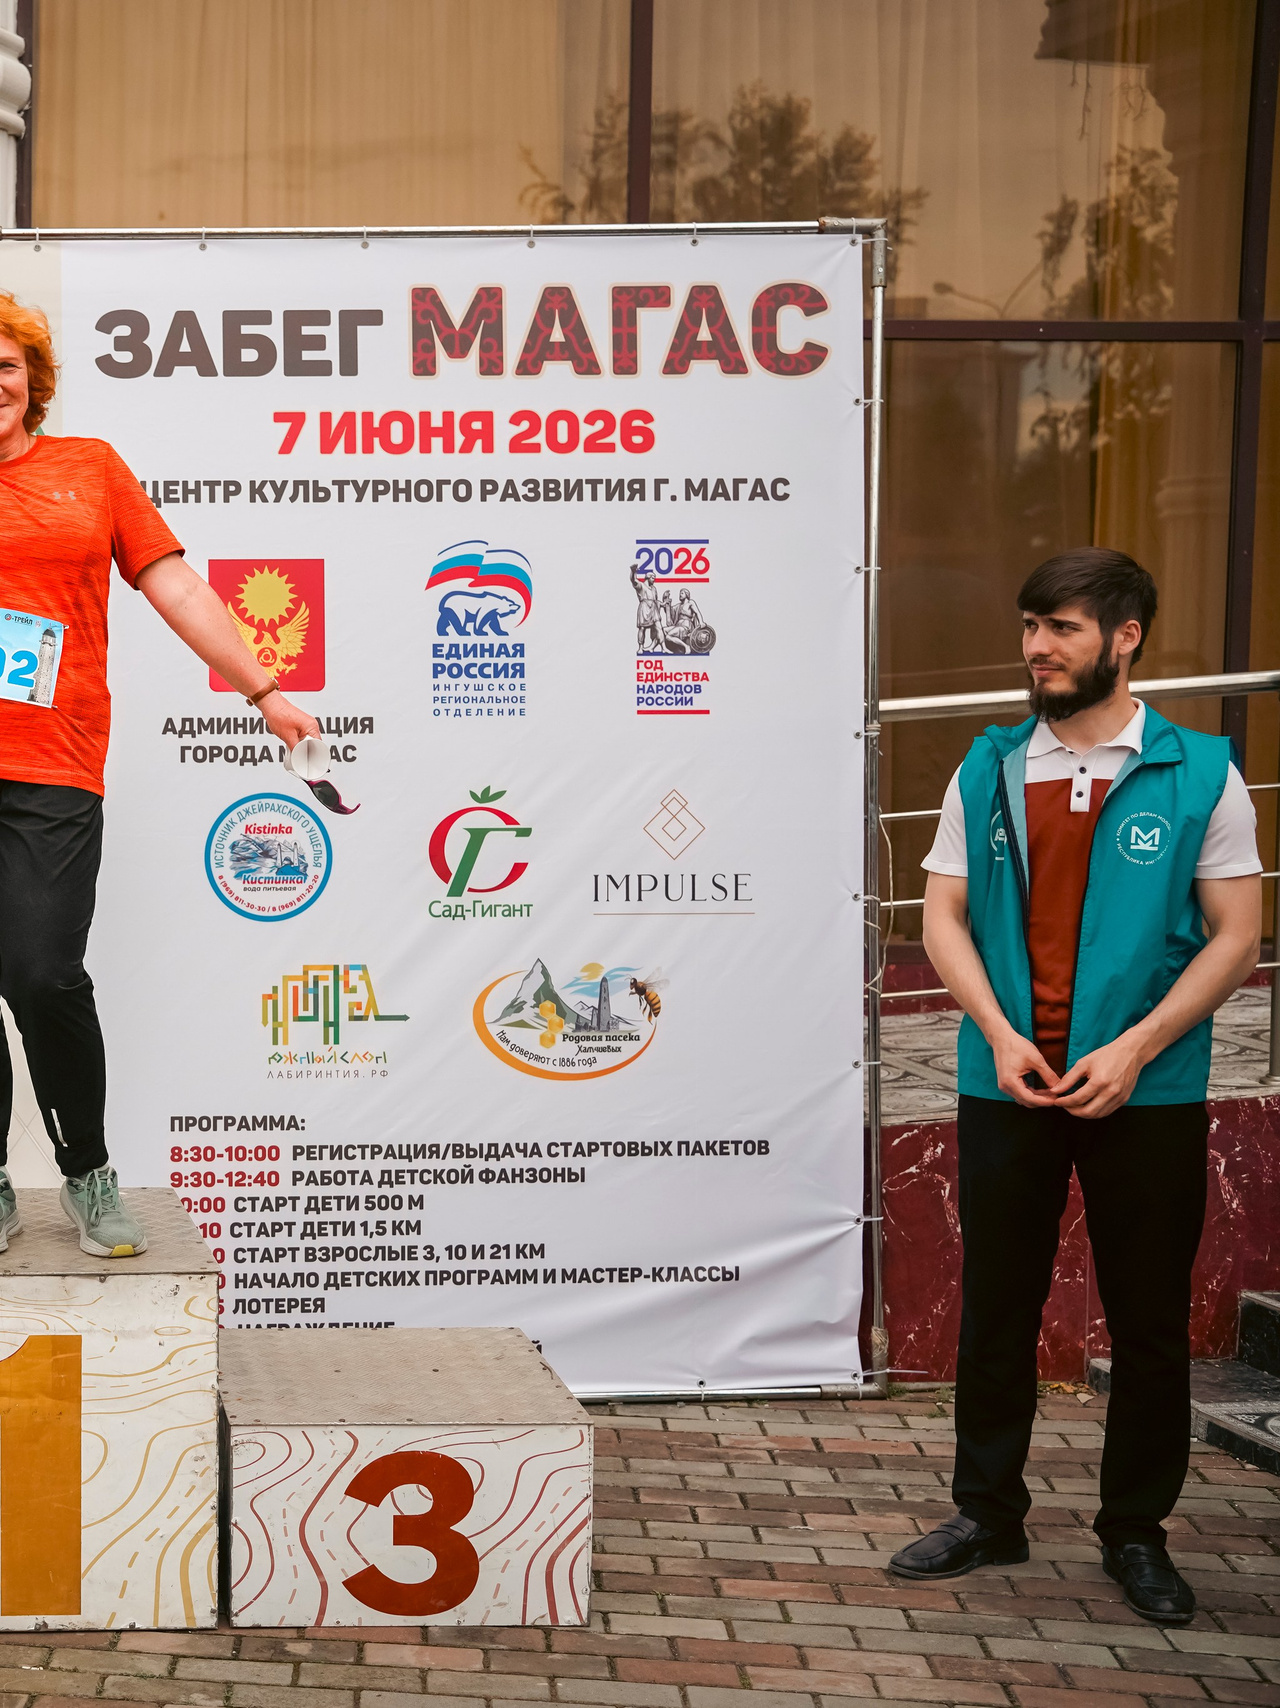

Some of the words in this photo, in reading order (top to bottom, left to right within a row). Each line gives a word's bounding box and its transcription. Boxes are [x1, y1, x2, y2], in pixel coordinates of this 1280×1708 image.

[94, 309, 382, 379] ЗАБЕГ
[410, 284, 830, 378] МАГАС
[273, 411, 306, 454] 7
[319, 411, 493, 454] ИЮНЯ
[508, 410, 656, 453] 2026
[139, 480, 242, 508] ЦЕНТР
[248, 477, 472, 505] КУЛЬТУРНОГО
[480, 477, 645, 503] РАЗВИТИЯ
[654, 477, 678, 502] Г.
[685, 477, 790, 502] МАГАС
[635, 547, 710, 575] 2026
[432, 643, 525, 660] ЕДИНАЯ
[432, 662, 525, 679] РОССИЯ
[636, 660, 664, 671] ГОД
[433, 683, 526, 692] ИНГУШСКОЕ
[636, 672, 709, 684] ЕДИНСТВА
[433, 695, 526, 705] РЕГИОНАЛЬНОЕ
[636, 684, 702, 696] НАРОДОВ
[636, 696, 694, 707] РОССИИ
[433, 708, 526, 718] ОТДЕЛЕНИЕ
[179, 745, 273, 766] ГОРОДА
[214, 817, 238, 868] ИСТОЧНИК
[236, 801, 310, 829] ДЖЕЙРАХСКОГО
[305, 827, 323, 868] УЩЕЛЬЯ
[244, 823, 293, 835] Kistinka
[242, 874, 304, 885] Кистинка
[243, 885, 261, 893] вода
[593, 873, 754, 902] IMPULSE
[428, 899, 534, 921] Сад-Гигант
[496, 1029, 510, 1047] Нам
[509, 1042, 551, 1067] доверяют
[552, 1059, 558, 1067] с
[558, 1057, 576, 1068] 1886
[577, 1056, 598, 1068] года
[562, 1033, 603, 1044] Родовая
[605, 1033, 641, 1043] пасека
[170, 1115, 306, 1132] ПРОГРАММА:
[170, 1145, 280, 1163] 8:30-10:00
[292, 1142, 542, 1162] РЕГИСТРАЦИЯ/ВЫДАЧА
[546, 1140, 673, 1158] СТАРТОВЫХ
[677, 1140, 770, 1156] ПАКЕТОВ
[170, 1171, 280, 1188] 9:30-12:40
[292, 1170, 373, 1187] РАБОТА
[377, 1164, 474, 1188] ДЕТСКОЙ
[478, 1167, 586, 1184] ФАНЗОНЫ
[181, 1197, 226, 1213] 0:00
[233, 1196, 300, 1213] СТАРТ
[304, 1195, 360, 1214] ДЕТИ
[364, 1195, 404, 1211] 500
[408, 1194, 425, 1211] М
[230, 1222, 296, 1239] СТАРТ
[300, 1221, 356, 1240] ДЕТИ
[360, 1220, 387, 1239] 1,5
[392, 1220, 422, 1236] КМ
[233, 1247, 300, 1264] СТАРТ
[304, 1245, 419, 1263] ВЗРОСЛЫЕ
[423, 1245, 440, 1263] 3,
[444, 1245, 467, 1261] 10
[471, 1245, 485, 1261] И
[489, 1244, 512, 1260] 21
[515, 1243, 545, 1260] КМ
[234, 1271, 320, 1289] НАЧАЛО
[323, 1271, 420, 1291] ДЕТСКИХ
[424, 1269, 538, 1287] ПРОГРАММ
[543, 1269, 557, 1284] И
[561, 1266, 740, 1285] МАСТЕР-КЛАССЫ
[232, 1297, 326, 1315] ЛОТЕРЕЯ
[342, 1449, 479, 1618] 3
